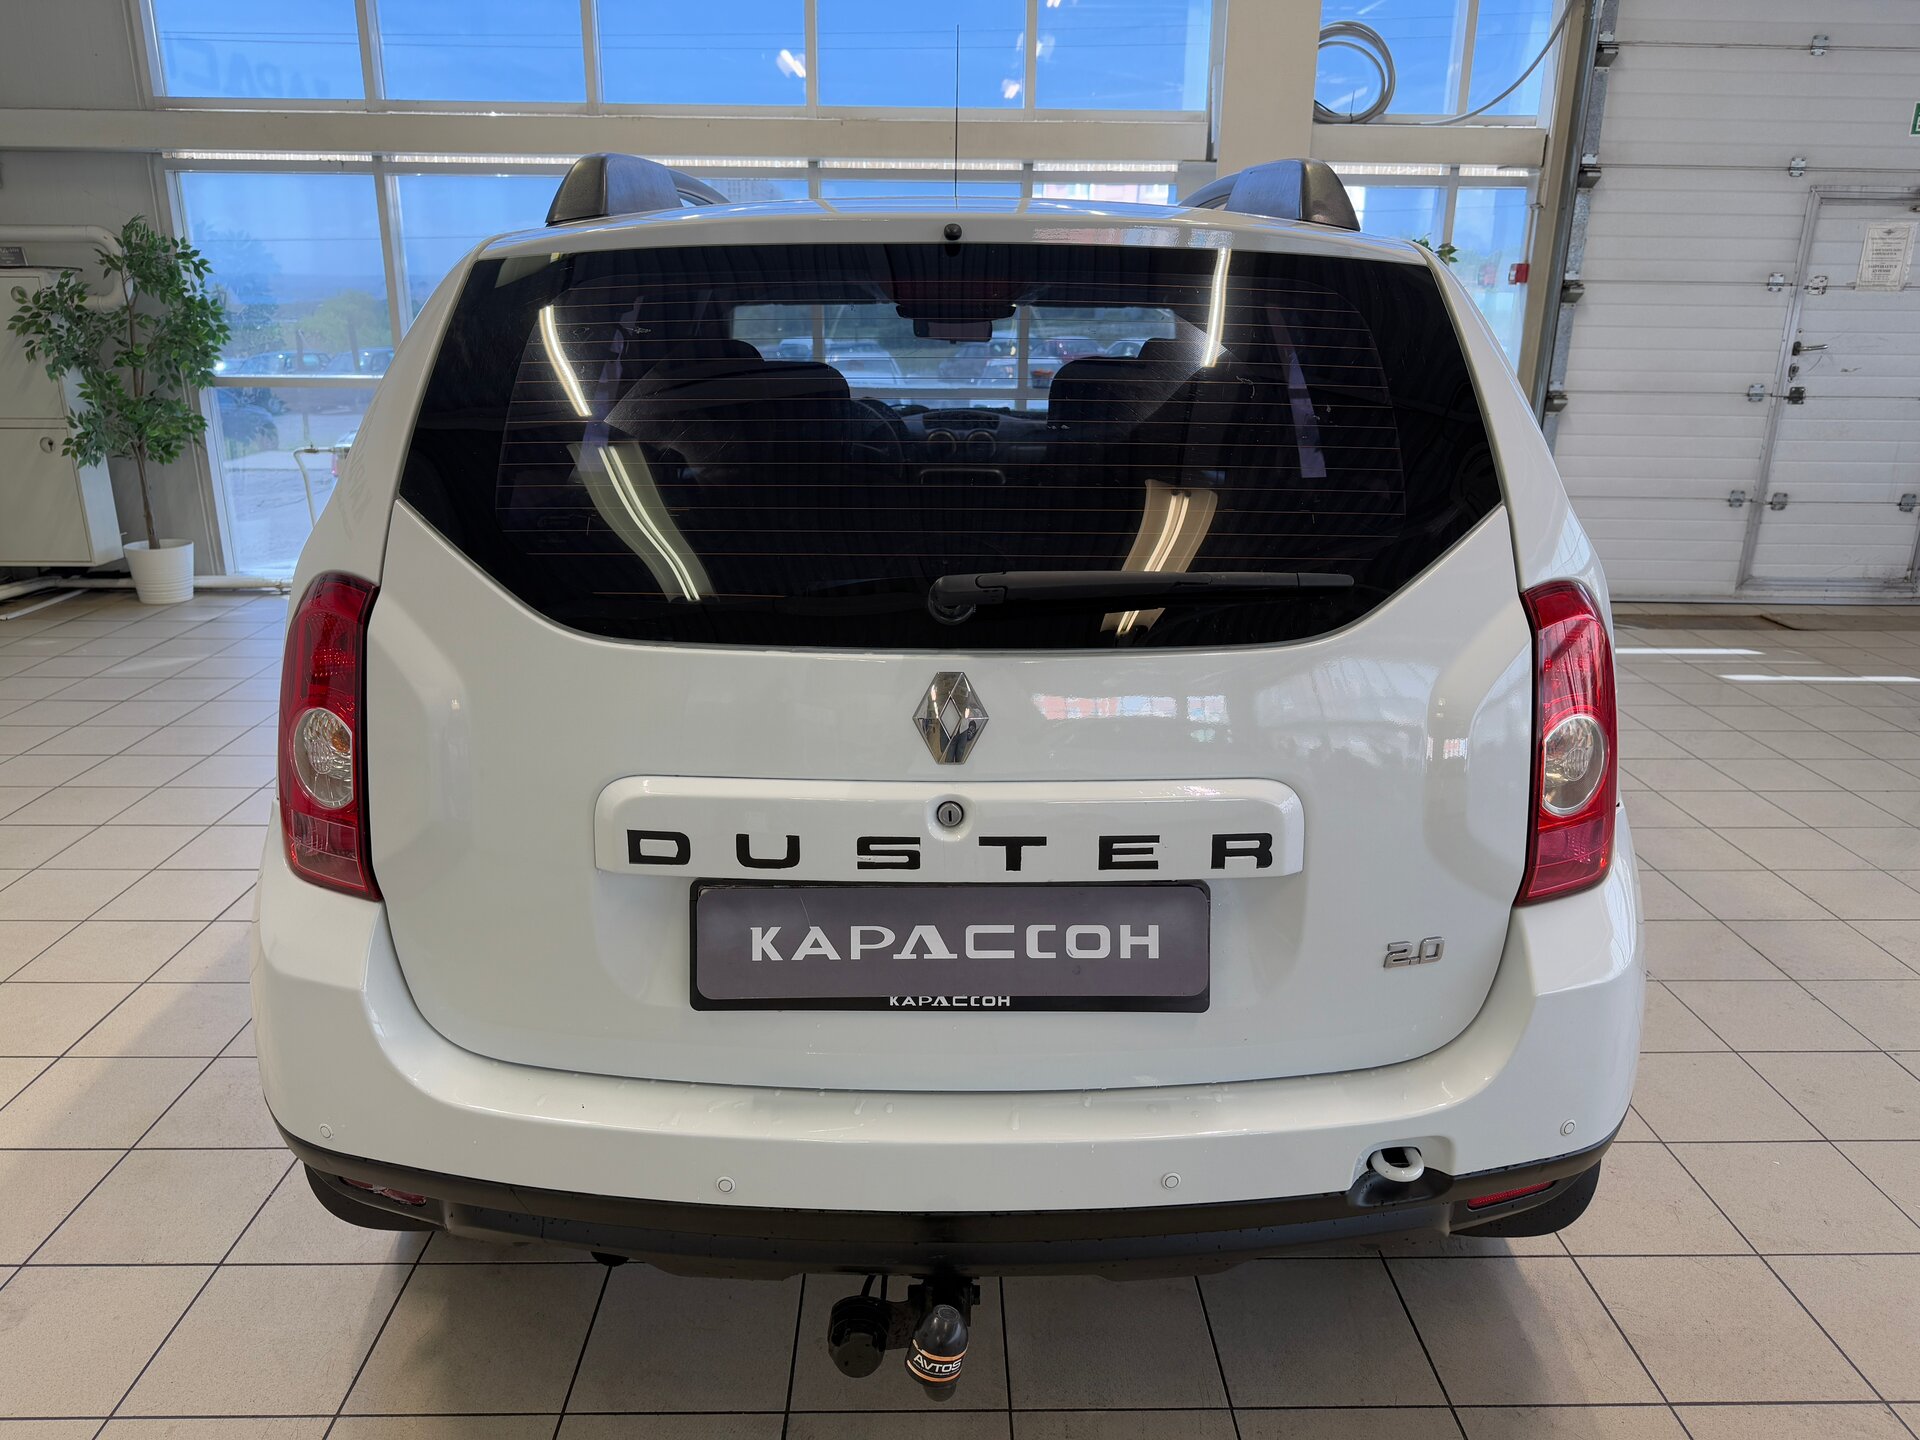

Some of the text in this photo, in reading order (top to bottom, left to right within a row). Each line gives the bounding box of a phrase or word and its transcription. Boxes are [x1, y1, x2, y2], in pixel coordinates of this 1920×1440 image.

[626, 830, 1273, 871] DUSTER
[750, 924, 1160, 961] КАРАССОН
[1383, 936, 1445, 968] 2.0
[889, 995, 1011, 1007] КАРАССОН
